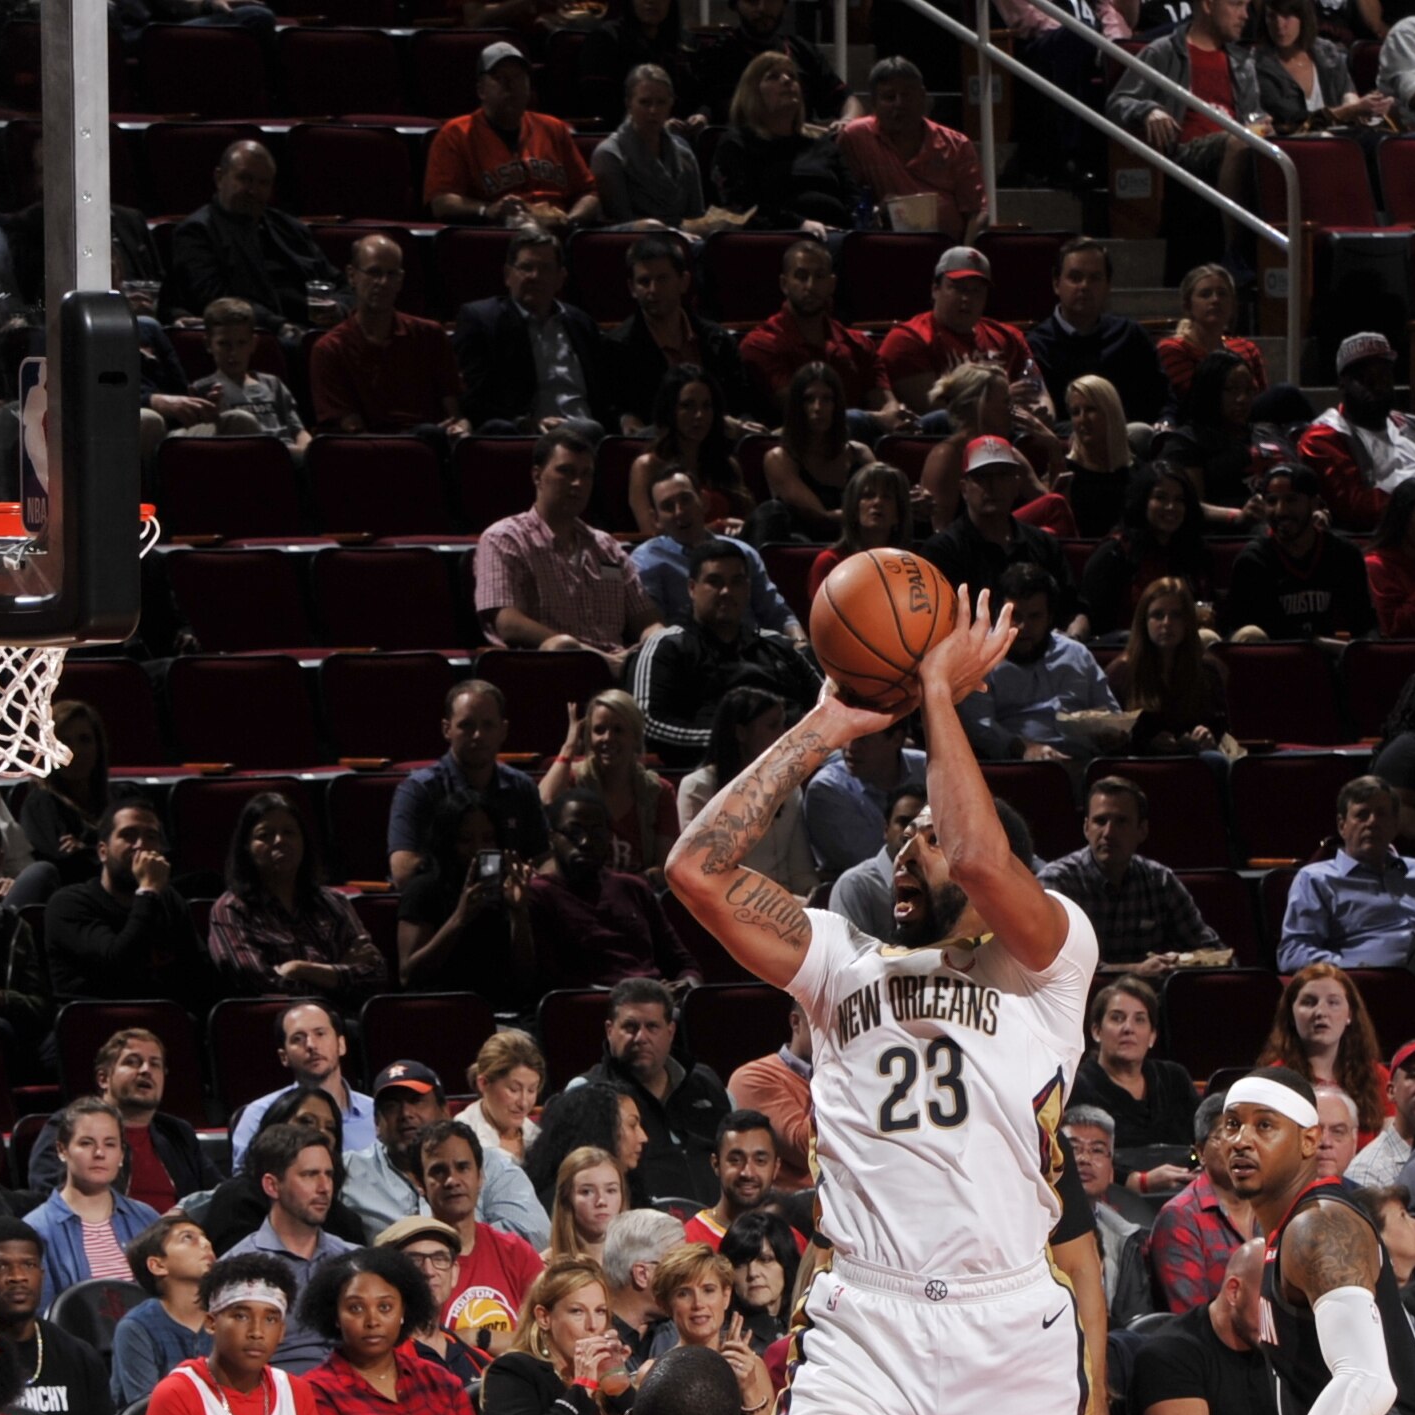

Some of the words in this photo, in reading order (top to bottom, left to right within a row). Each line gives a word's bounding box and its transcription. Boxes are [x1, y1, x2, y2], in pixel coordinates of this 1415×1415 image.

[27, 496, 47, 525] NBA
[837, 978, 882, 1049] NEW
[888, 974, 1000, 1038] ORLEANS
[877, 1035, 969, 1134] 23
[16, 1385, 70, 1413] NCHY
